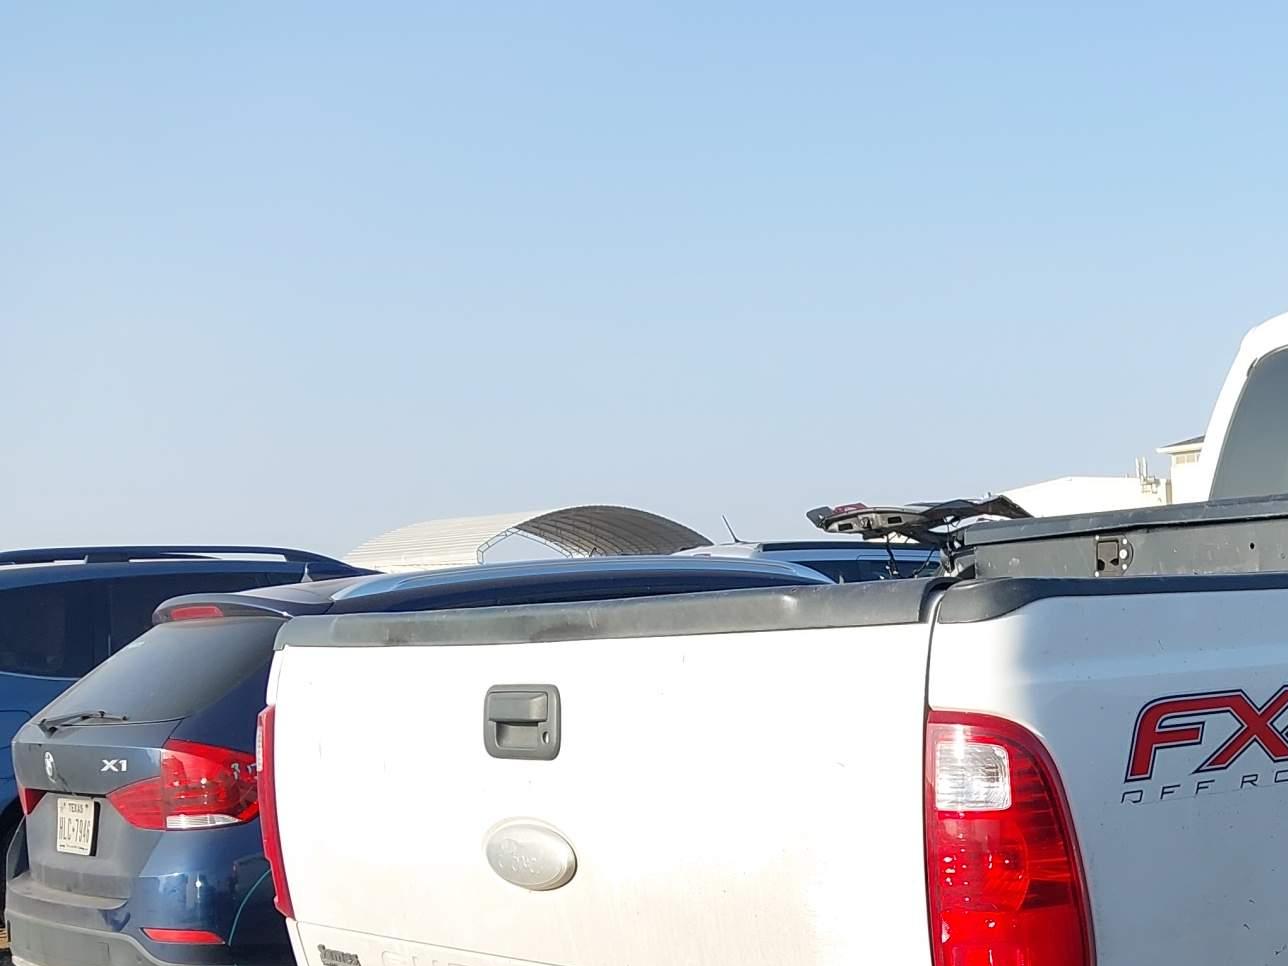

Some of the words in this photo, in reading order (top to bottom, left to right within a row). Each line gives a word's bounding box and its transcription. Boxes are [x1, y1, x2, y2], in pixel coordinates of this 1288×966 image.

[101, 759, 127, 772] X1
[1121, 779, 1215, 804] OFF
[68, 802, 84, 814] TEXAS
